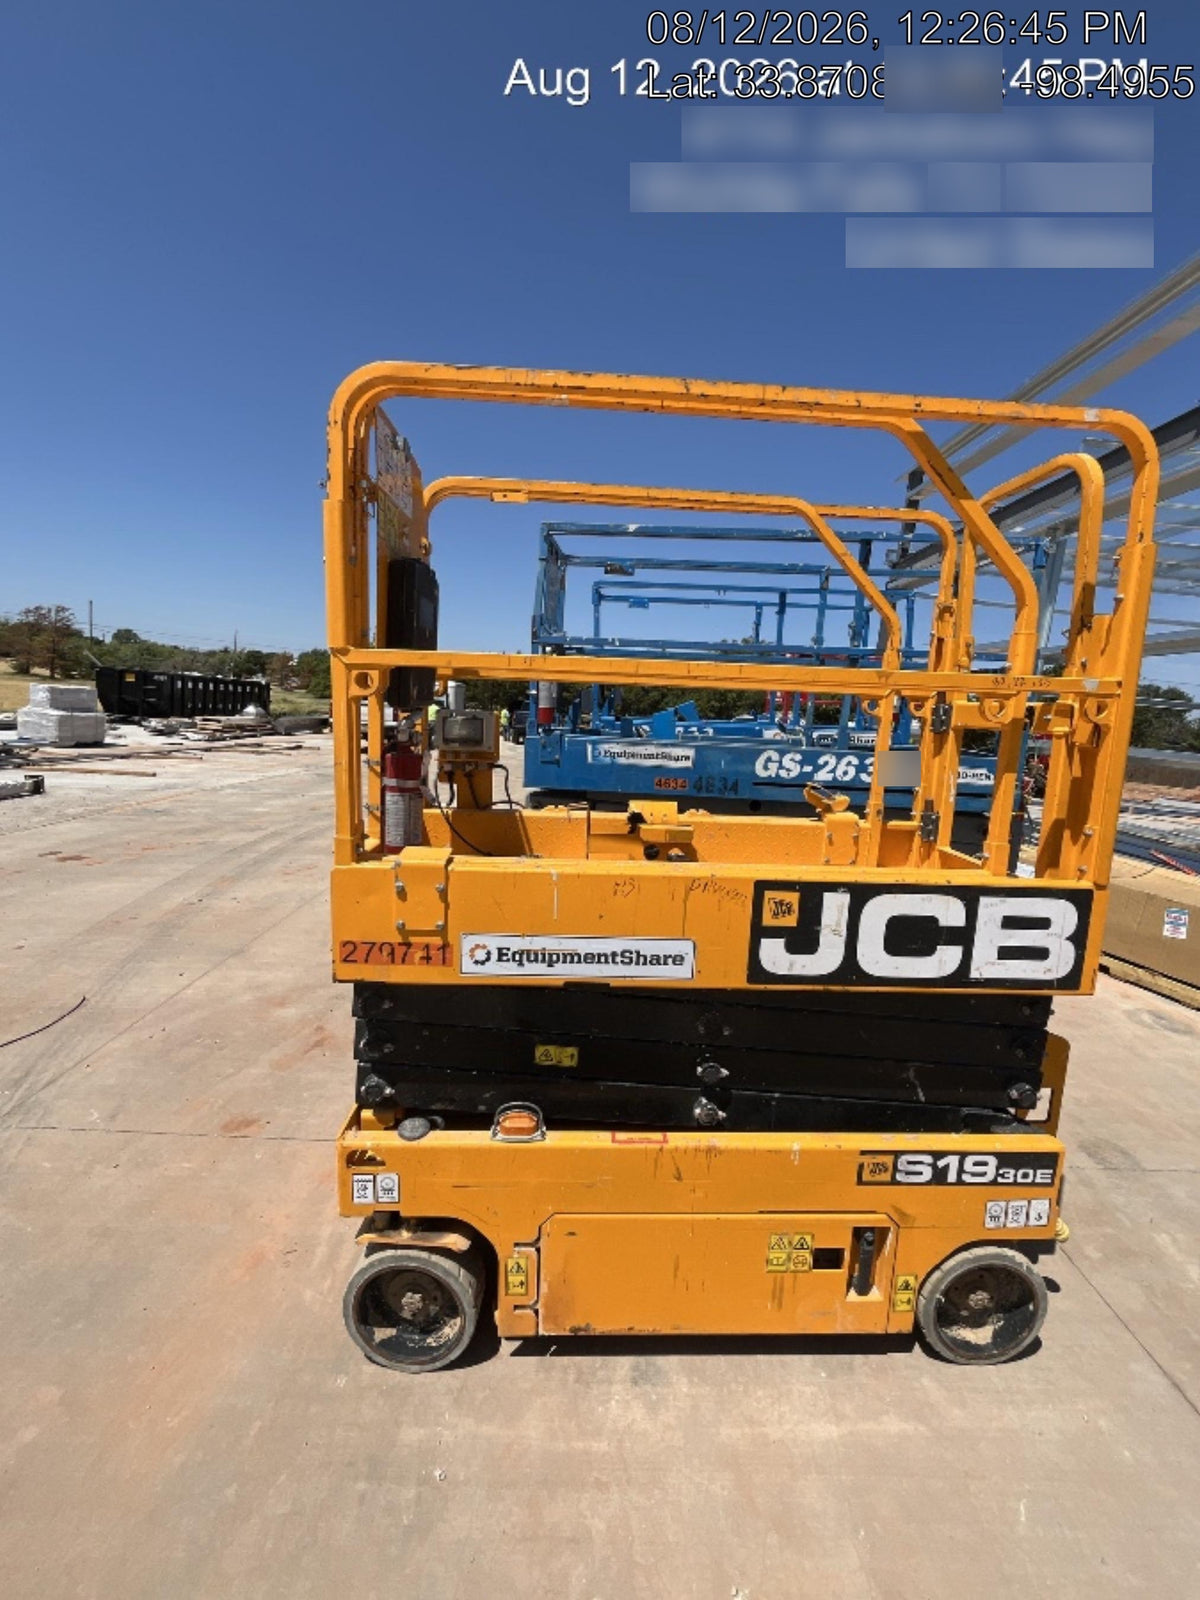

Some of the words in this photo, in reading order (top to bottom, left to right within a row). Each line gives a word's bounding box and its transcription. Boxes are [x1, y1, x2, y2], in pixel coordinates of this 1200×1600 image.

[755, 750, 878, 783] GS-263
[758, 891, 1080, 981] JCB
[495, 946, 688, 968] EquipmentShare
